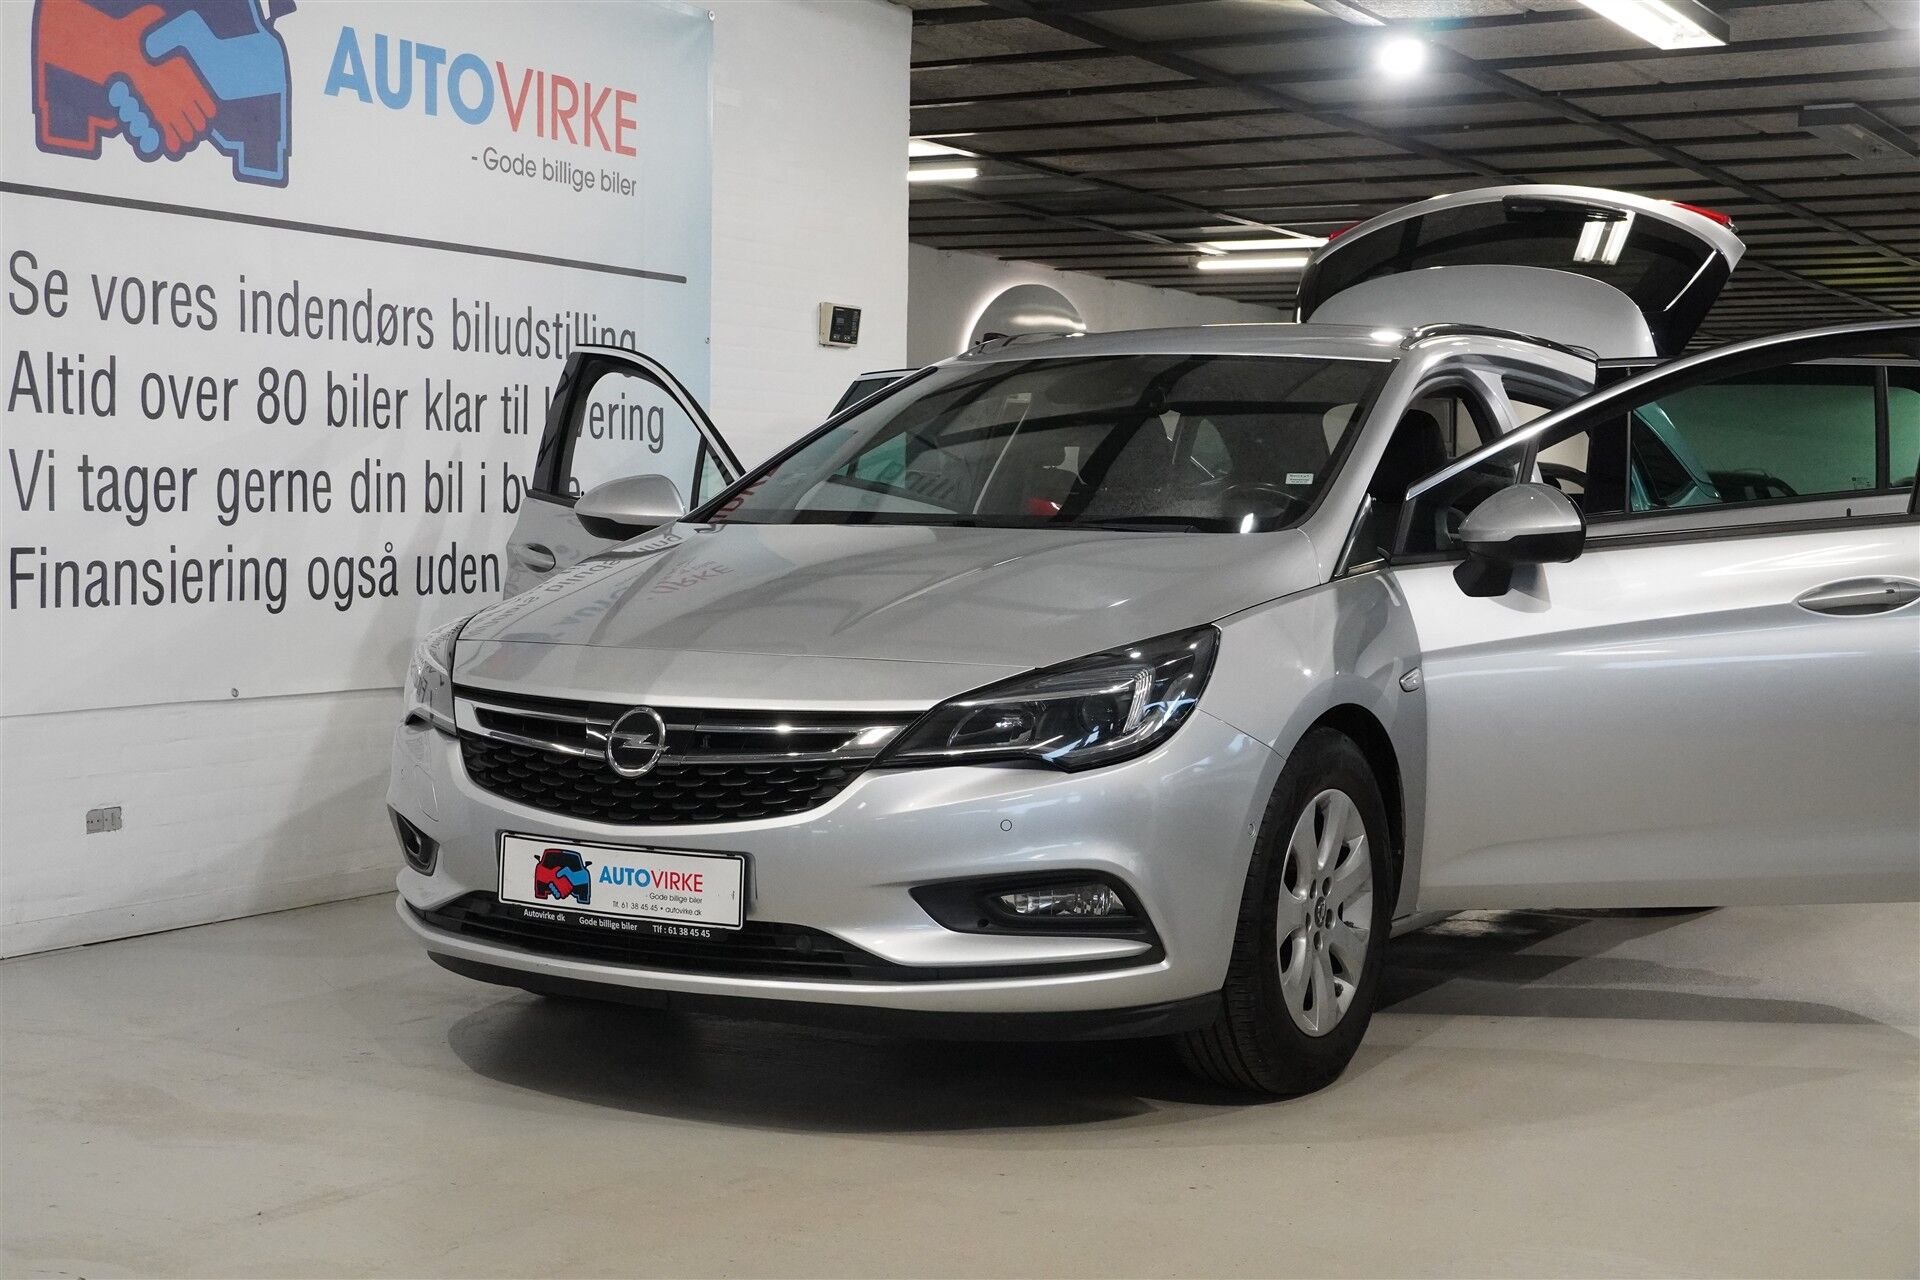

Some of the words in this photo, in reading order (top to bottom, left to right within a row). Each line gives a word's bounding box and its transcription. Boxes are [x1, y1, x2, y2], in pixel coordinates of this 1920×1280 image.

[324, 25, 637, 157] AUTOVIRKE
[484, 147, 537, 178] Gode
[543, 158, 595, 192] billige
[601, 168, 637, 196] biler
[9, 250, 69, 318] Se
[91, 274, 218, 334] vores
[240, 274, 434, 350] indendørs
[8, 350, 117, 418] Altid
[140, 372, 239, 423] over
[257, 367, 307, 426] 80
[327, 371, 408, 430] biler
[426, 378, 487, 435] klar
[500, 384, 529, 435] til
[545, 386, 664, 454] lering
[9, 448, 56, 512] Vi
[77, 454, 198, 526] tager
[216, 468, 332, 526] gerne
[350, 458, 406, 514] din
[424, 460, 463, 514] bil
[480, 462, 486, 514] i
[10, 544, 287, 614] Finansiering
[307, 542, 399, 612] også
[416, 542, 500, 597] uden
[599, 865, 703, 892] AUTOVIRKE
[649, 892, 668, 901] Gode
[669, 895, 688, 904] billige
[689, 896, 702, 904] biler
[579, 916, 598, 927] Gode
[599, 918, 620, 930] billige
[621, 921, 638, 931] biler
[621, 901, 629, 909] 61
[631, 902, 639, 910] 38
[640, 903, 649, 911] 45
[650, 904, 658, 912] 45
[668, 926, 677, 935] 61
[679, 927, 689, 936] 38
[690, 928, 700, 937] 45
[700, 929, 711, 938] 45
